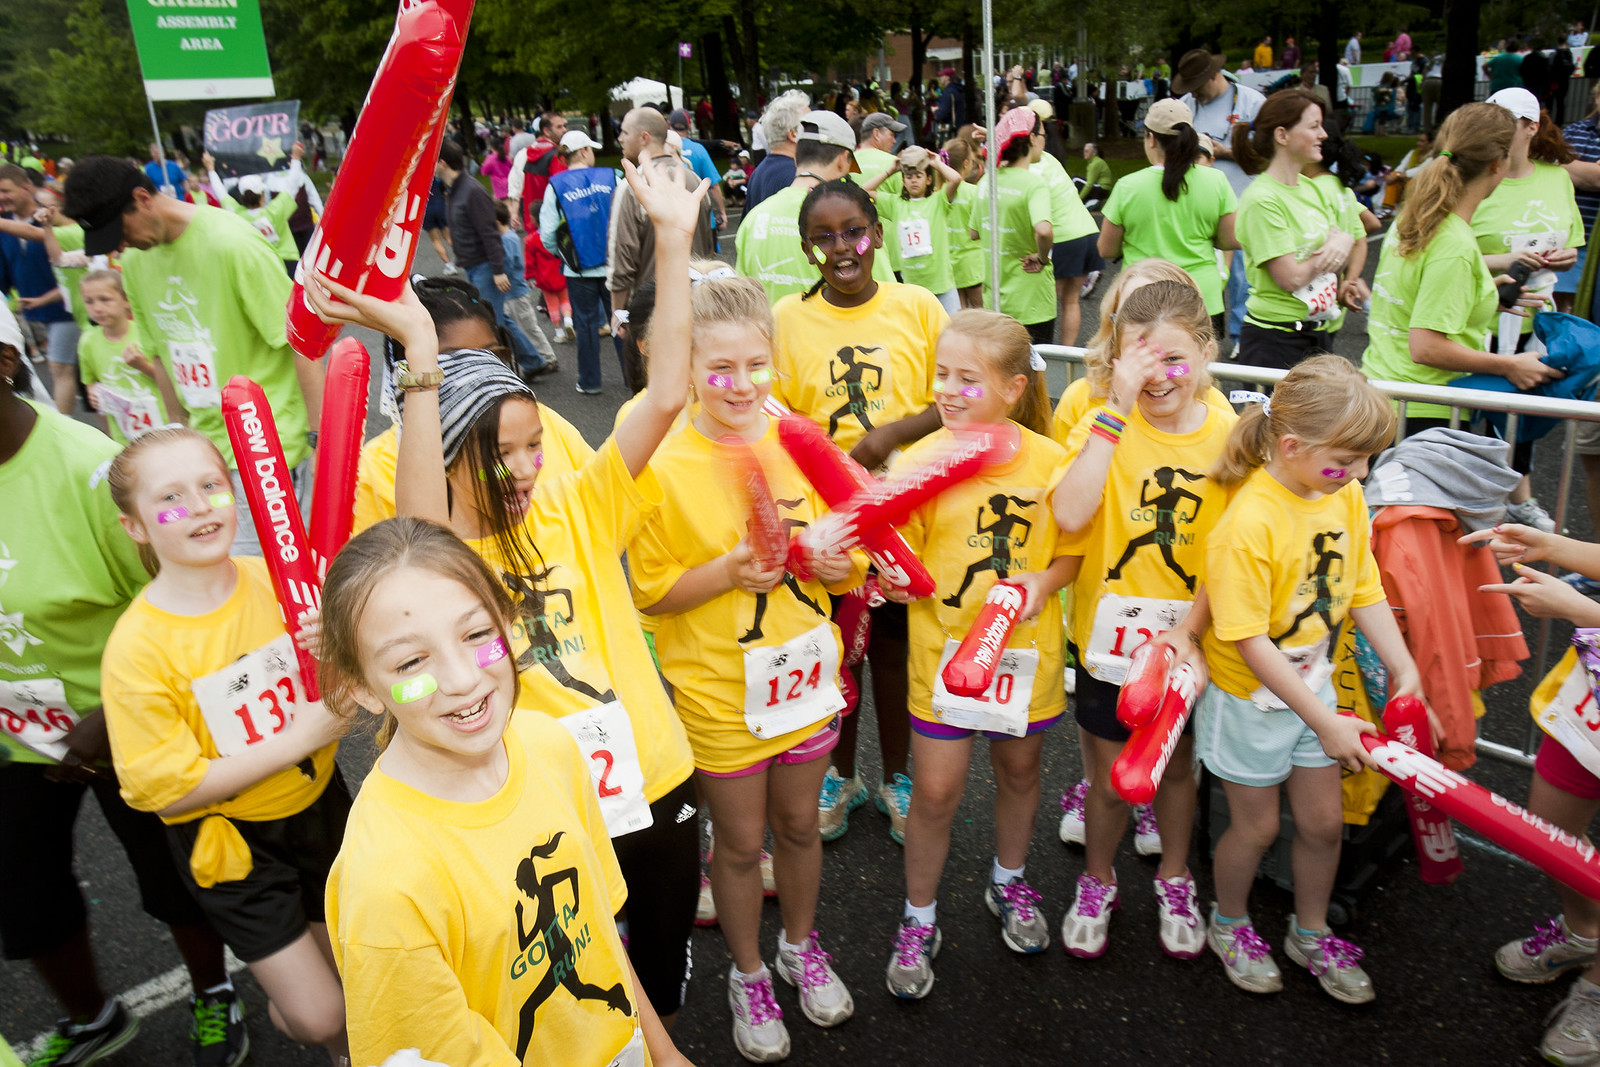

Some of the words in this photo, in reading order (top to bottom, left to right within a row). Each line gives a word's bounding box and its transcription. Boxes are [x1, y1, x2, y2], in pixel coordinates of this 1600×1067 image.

[156, 15, 237, 29] ASSEMBLY
[180, 37, 224, 51] AREA
[210, 112, 291, 143] GOTR
[563, 182, 613, 203] Volunteer
[906, 230, 922, 247] 15
[825, 381, 877, 398] GOTTA
[849, 399, 886, 415] RUN!
[237, 400, 270, 454] new
[254, 455, 300, 564] balance
[1130, 508, 1190, 525] GOTTA
[967, 534, 1022, 550] GOTTA
[1153, 532, 1196, 547] RUN!
[989, 557, 1028, 571] RUN!
[511, 611, 569, 641] OTTA
[978, 613, 1011, 652] balance
[532, 634, 587, 665] RUN!
[973, 640, 995, 671] new
[766, 661, 822, 708] 124
[590, 749, 623, 799] 2
[510, 903, 576, 981] GOTTA
[552, 922, 592, 987] RUN!
